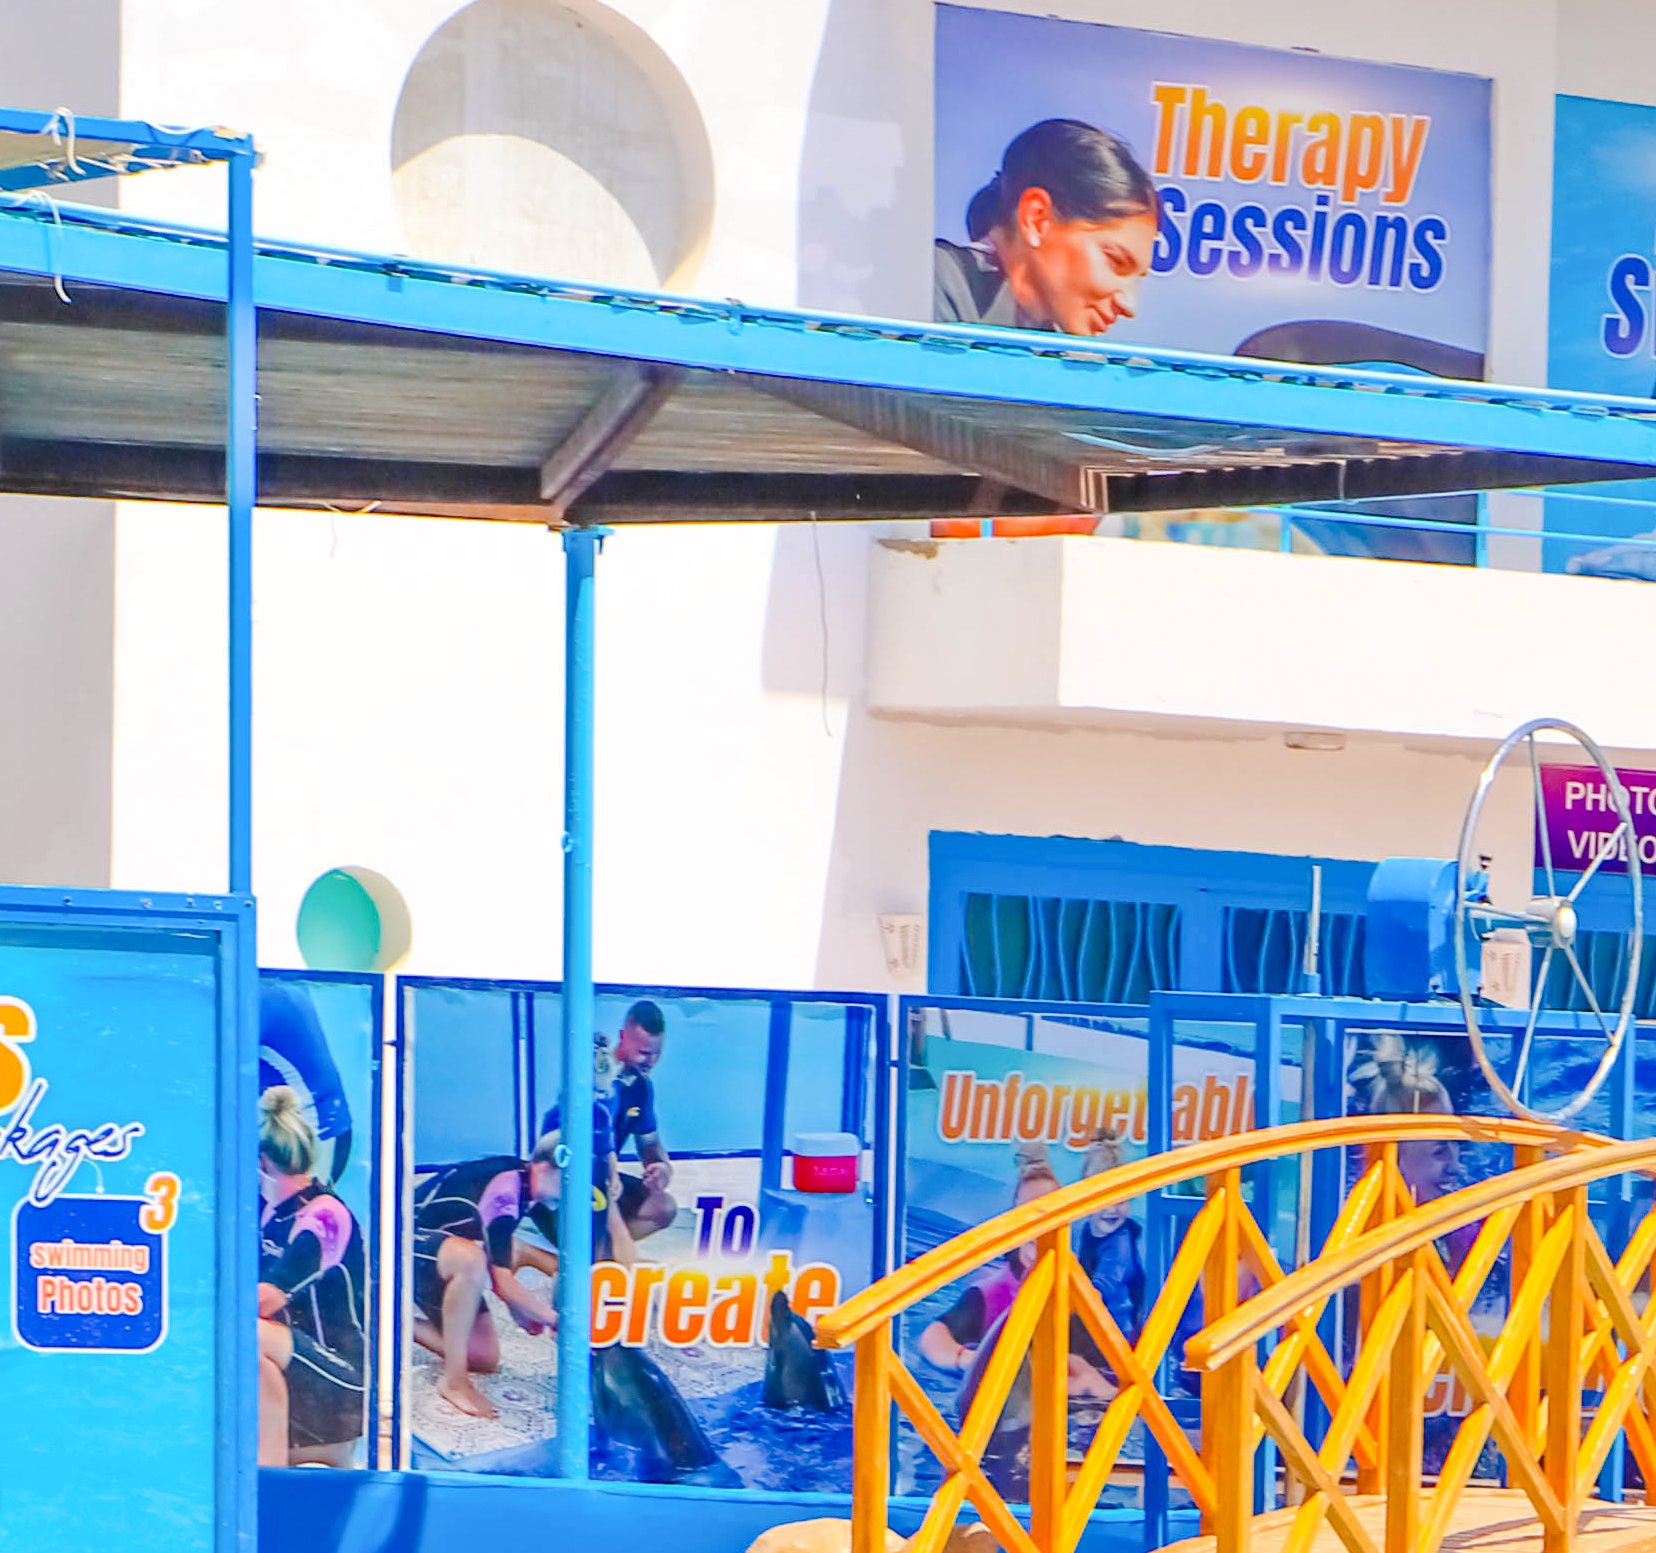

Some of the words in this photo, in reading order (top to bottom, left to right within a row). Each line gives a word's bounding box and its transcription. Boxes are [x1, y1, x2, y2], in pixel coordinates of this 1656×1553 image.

[1153, 85, 1430, 205] Therapy
[1150, 186, 1448, 291] Sessions
[142, 1173, 180, 1233] 3
[695, 1194, 758, 1260] To
[30, 1239, 150, 1274] swimming
[38, 1275, 143, 1315] Photos
